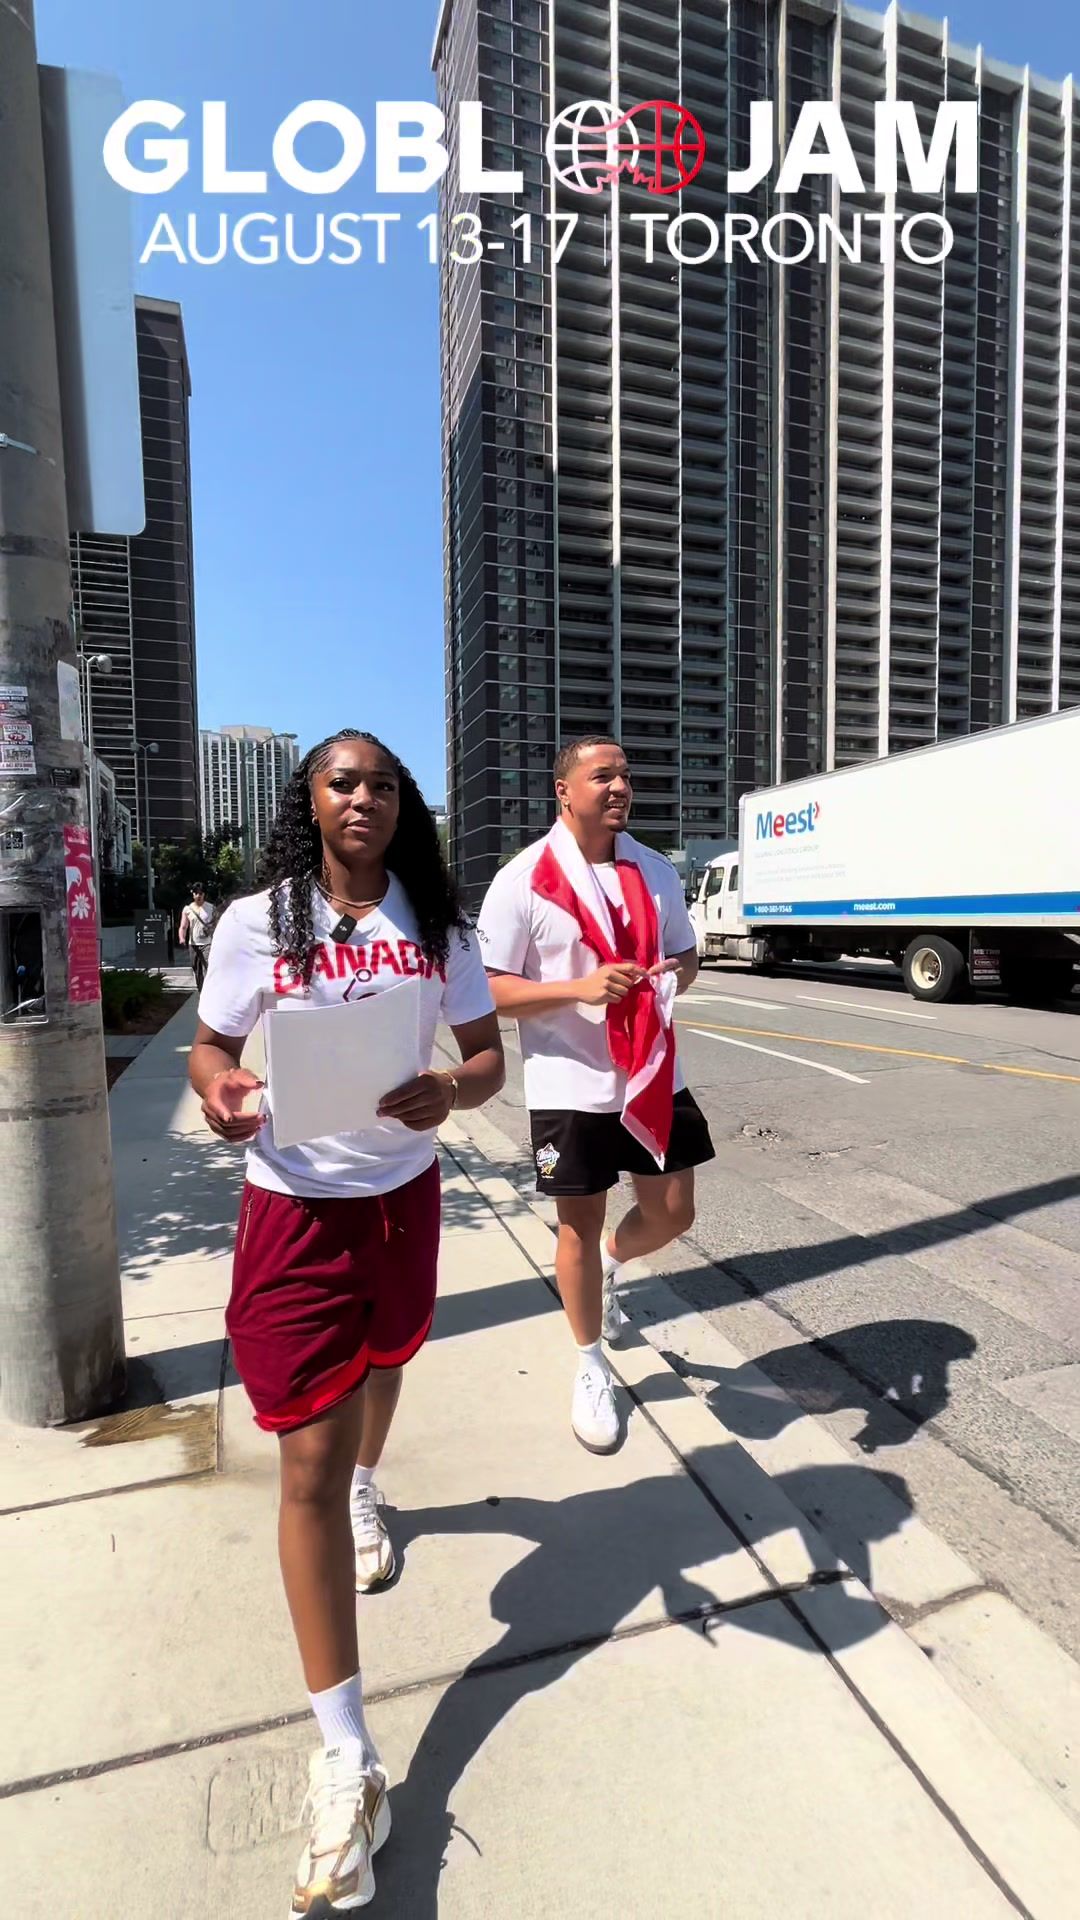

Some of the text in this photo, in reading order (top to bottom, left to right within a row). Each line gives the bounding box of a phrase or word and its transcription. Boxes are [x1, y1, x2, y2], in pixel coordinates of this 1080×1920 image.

[756, 802, 815, 840] Meest
[853, 902, 897, 912] meest.com
[273, 939, 447, 995] CANADA
